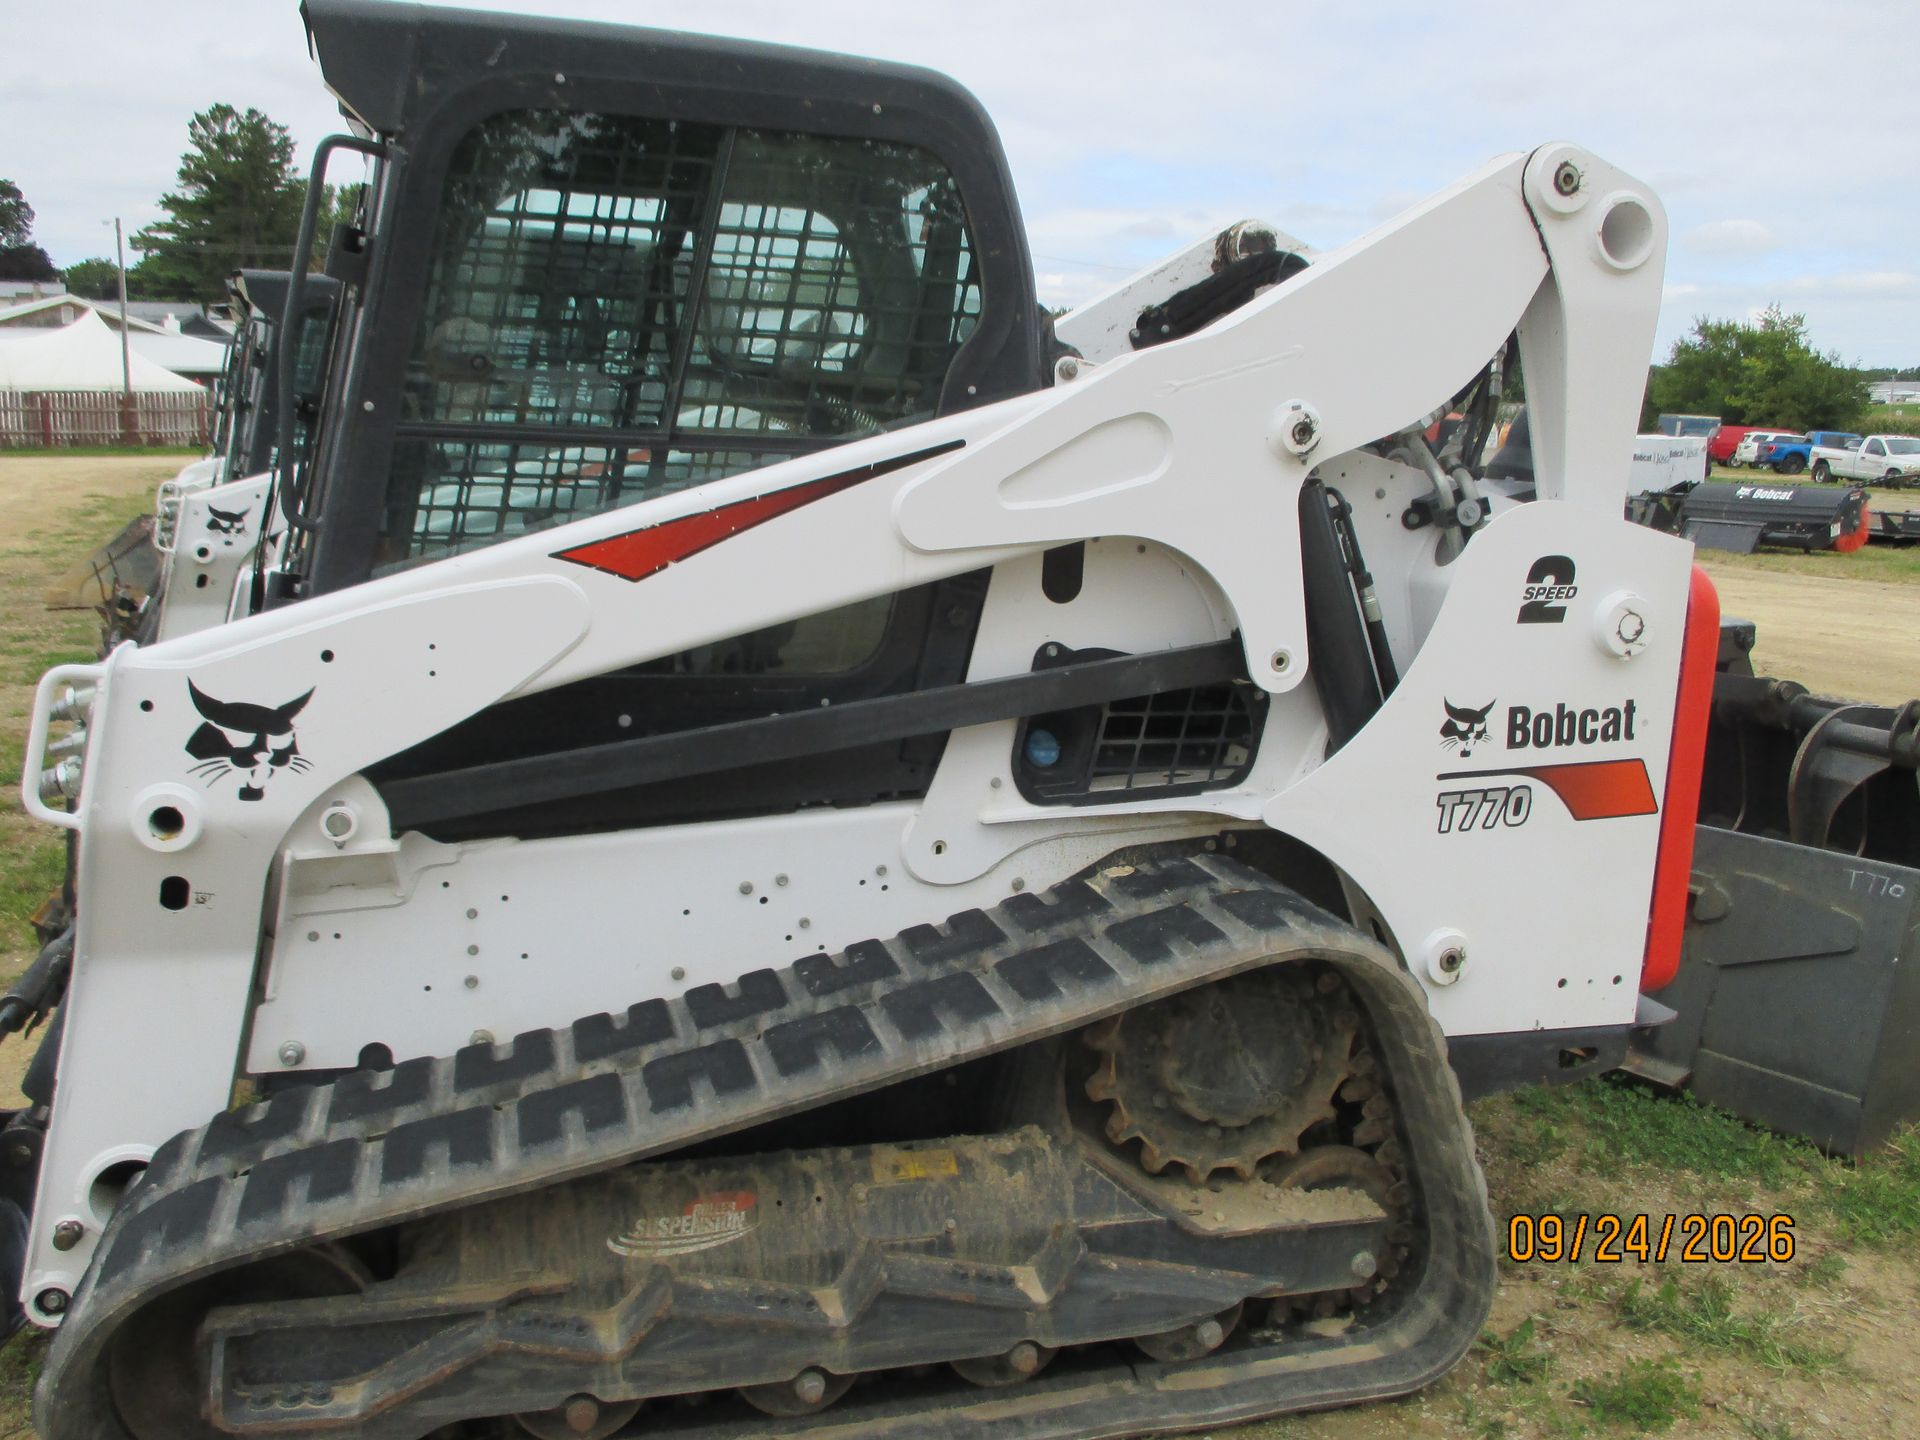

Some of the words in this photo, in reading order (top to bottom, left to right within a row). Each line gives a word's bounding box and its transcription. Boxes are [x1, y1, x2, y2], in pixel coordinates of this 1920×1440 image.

[1752, 488, 1794, 500] Bobcat
[1517, 555, 1576, 623] 2
[1523, 586, 1577, 600] SPEED
[1507, 699, 1635, 749] Bobcat
[1437, 785, 1531, 833] T770
